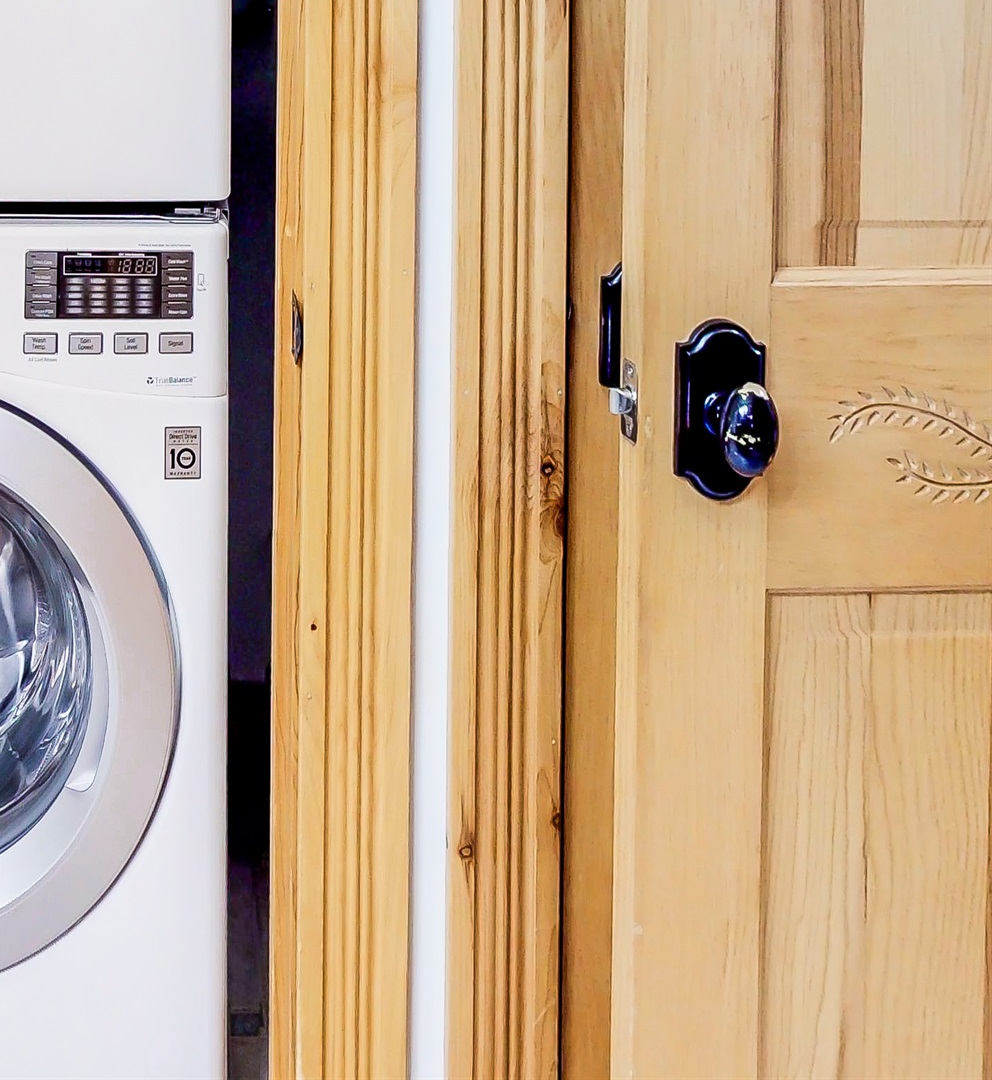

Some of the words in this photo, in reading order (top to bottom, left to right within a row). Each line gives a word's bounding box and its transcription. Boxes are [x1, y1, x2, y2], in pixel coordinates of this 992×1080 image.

[80, 337, 91, 345] Spin
[167, 339, 184, 348] Signal
[77, 343, 94, 351] Speed
[123, 343, 138, 351] Level
[169, 447, 196, 470] 10
